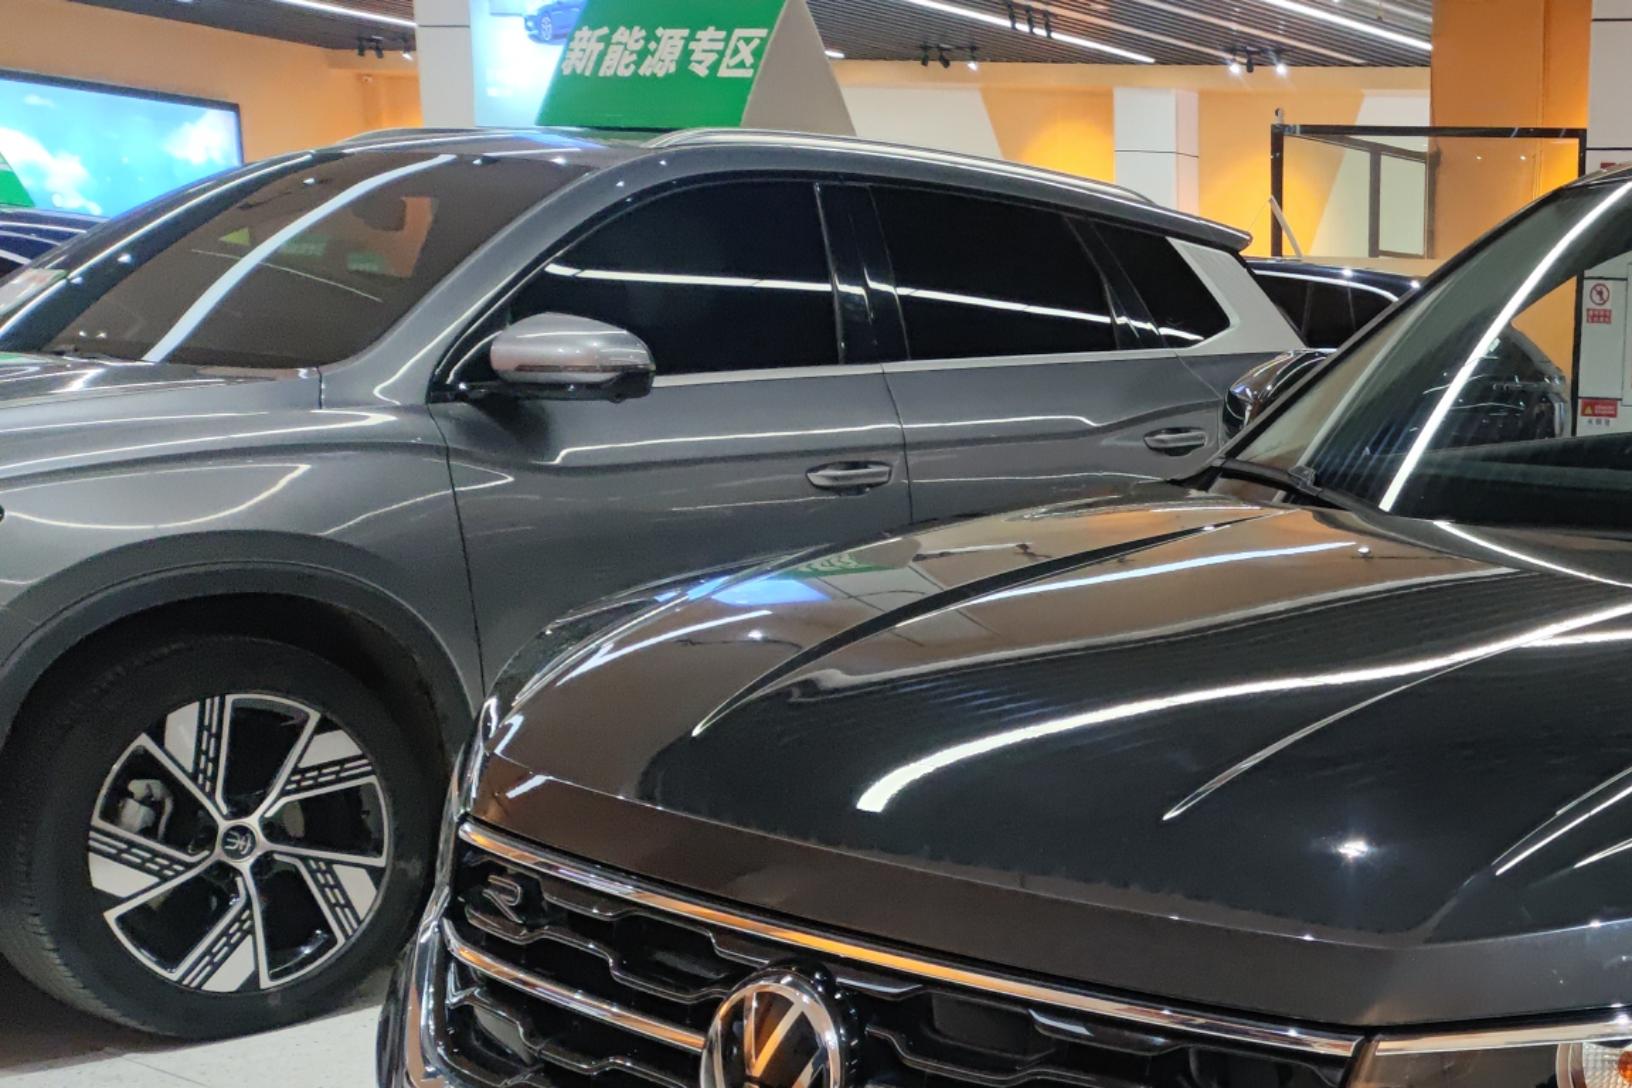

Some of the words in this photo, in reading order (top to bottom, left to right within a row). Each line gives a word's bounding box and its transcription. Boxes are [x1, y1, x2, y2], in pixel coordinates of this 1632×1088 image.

[561, 25, 769, 77] 新能源专区
[482, 873, 524, 924] R
